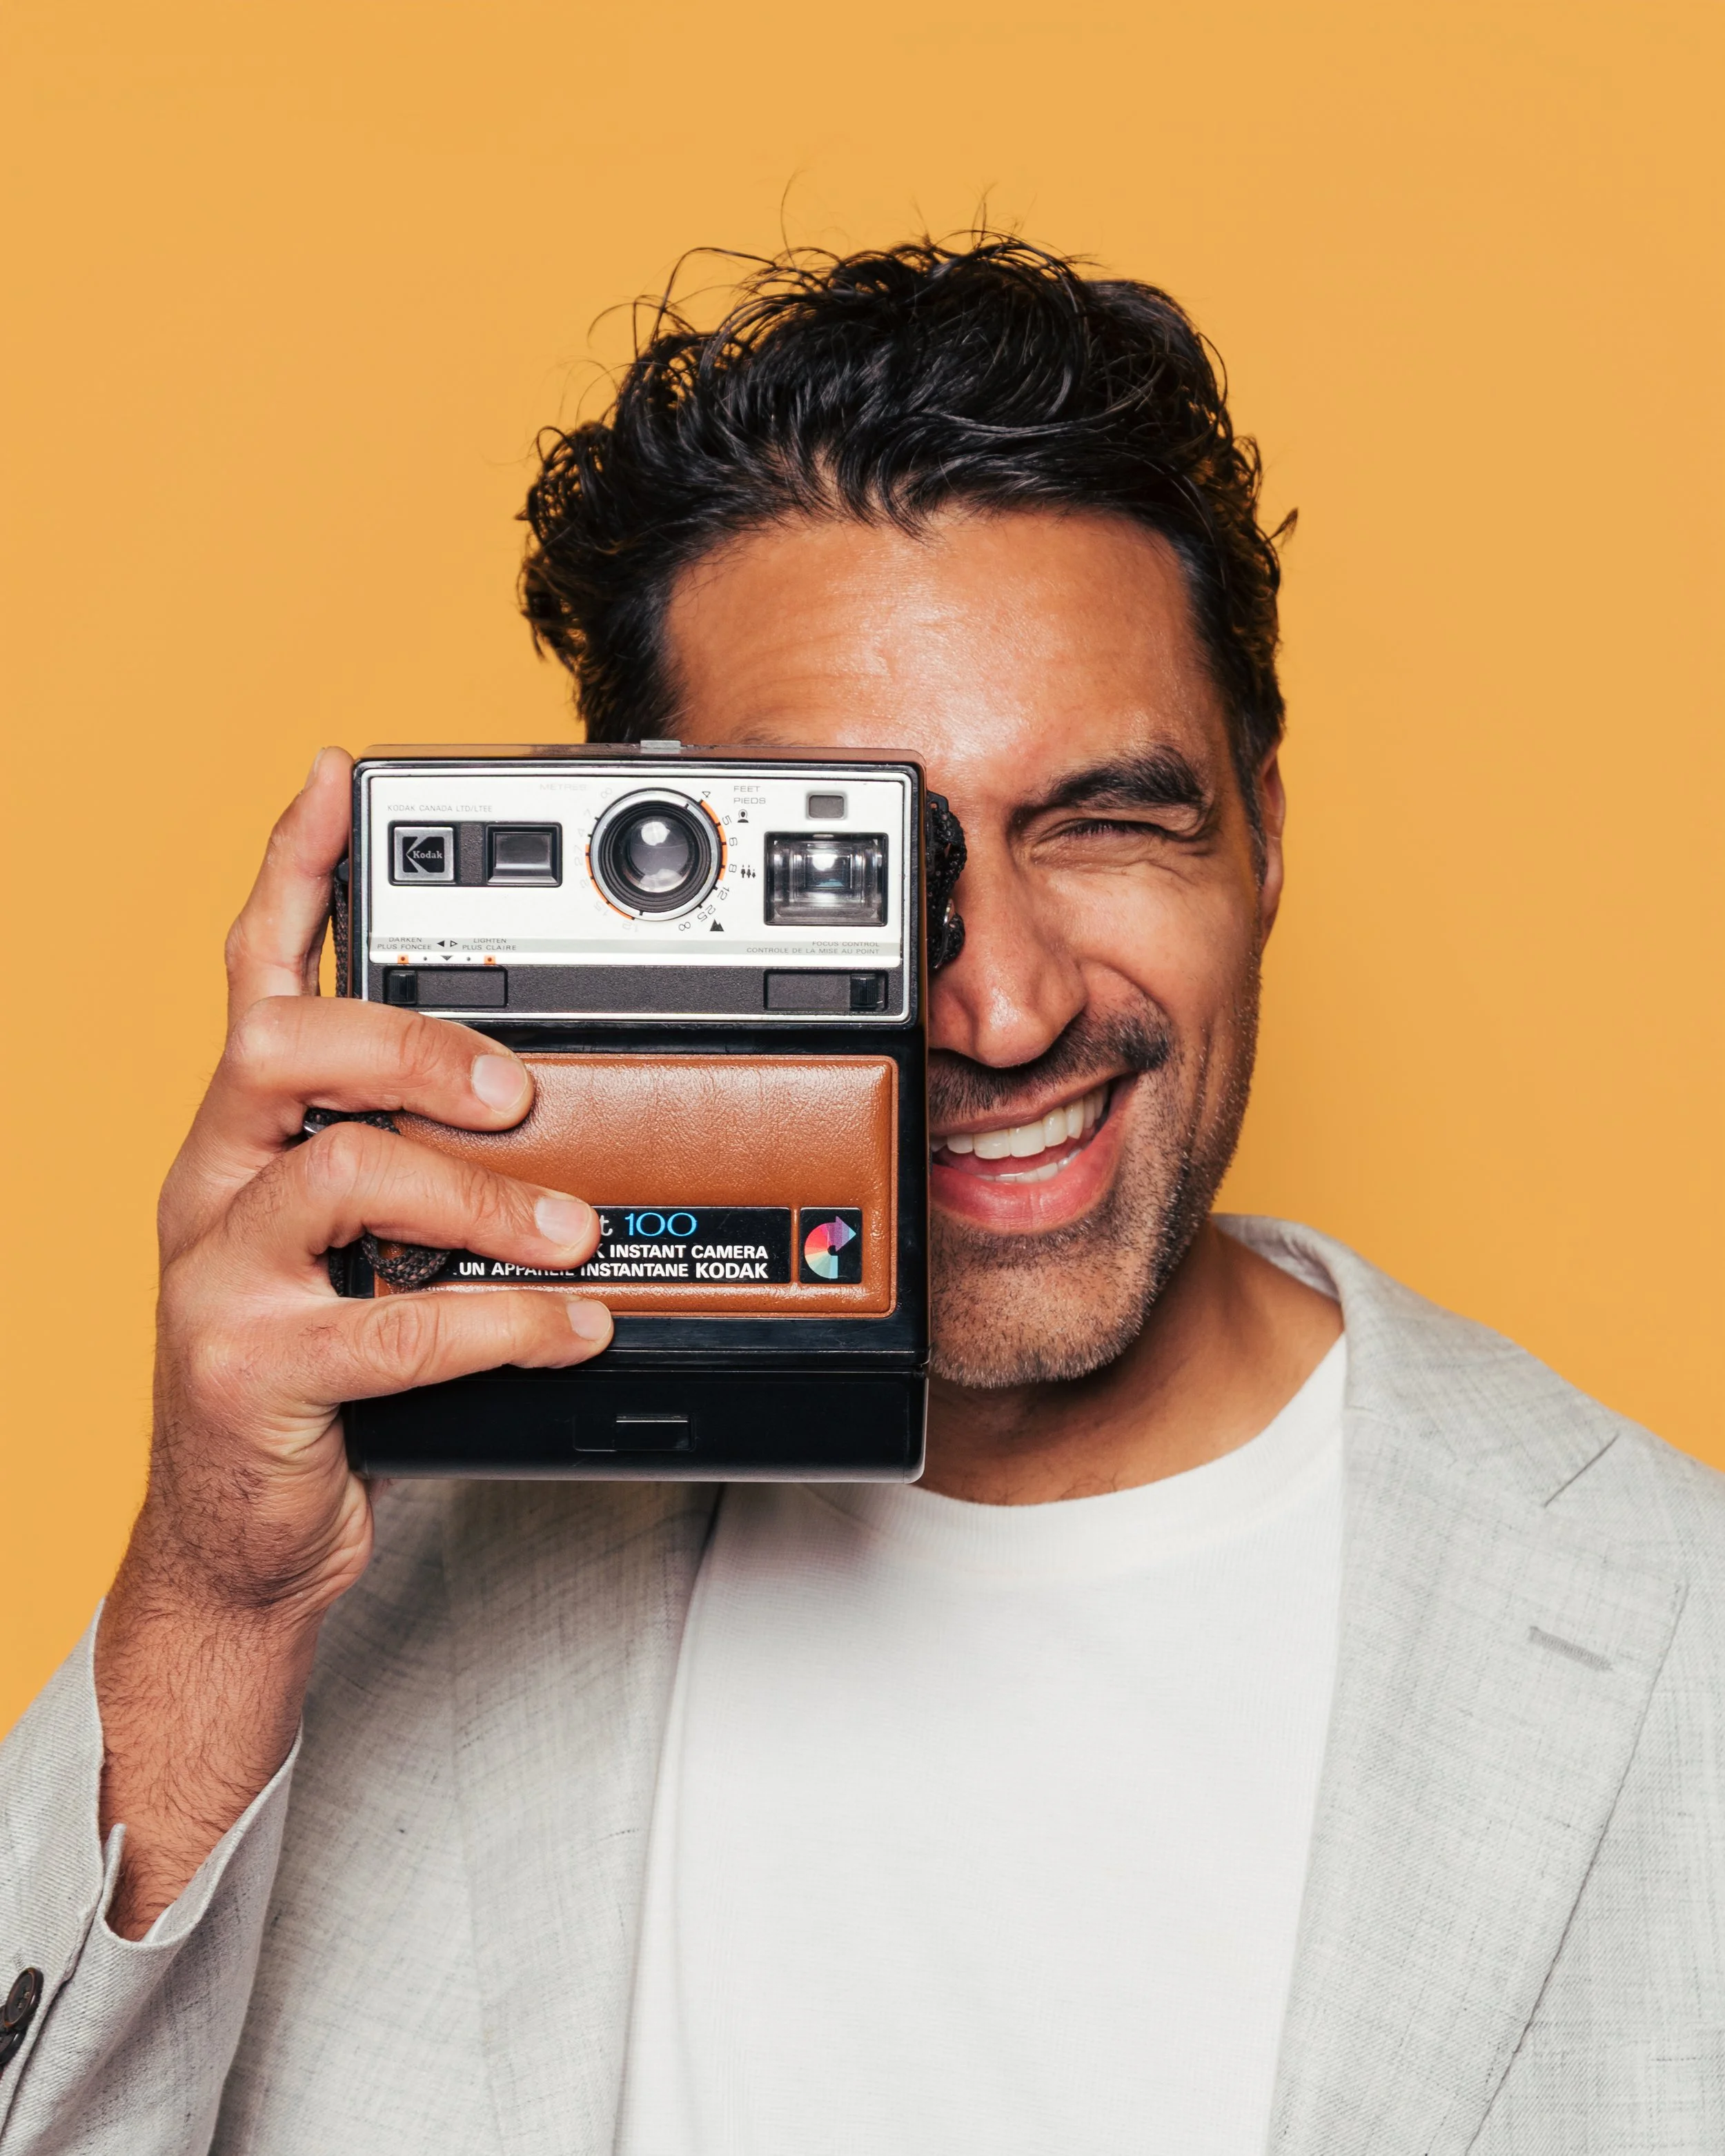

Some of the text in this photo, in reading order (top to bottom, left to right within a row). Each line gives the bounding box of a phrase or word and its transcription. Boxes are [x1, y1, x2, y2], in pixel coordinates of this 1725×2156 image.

[722, 815, 732, 825] 5
[577, 828, 585, 838] 4
[729, 837, 738, 847] 6
[413, 850, 442, 859] Kodak
[729, 864, 737, 873] 8
[717, 887, 730, 900] 12
[697, 904, 716, 922] 25
[624, 1212, 698, 1236] 100
[610, 1244, 687, 1258] INSTANT
[691, 1245, 769, 1259] CAMERA
[459, 1262, 484, 1276] UN
[580, 1263, 689, 1276] INSTANTANE
[696, 1263, 769, 1278] KODAK
